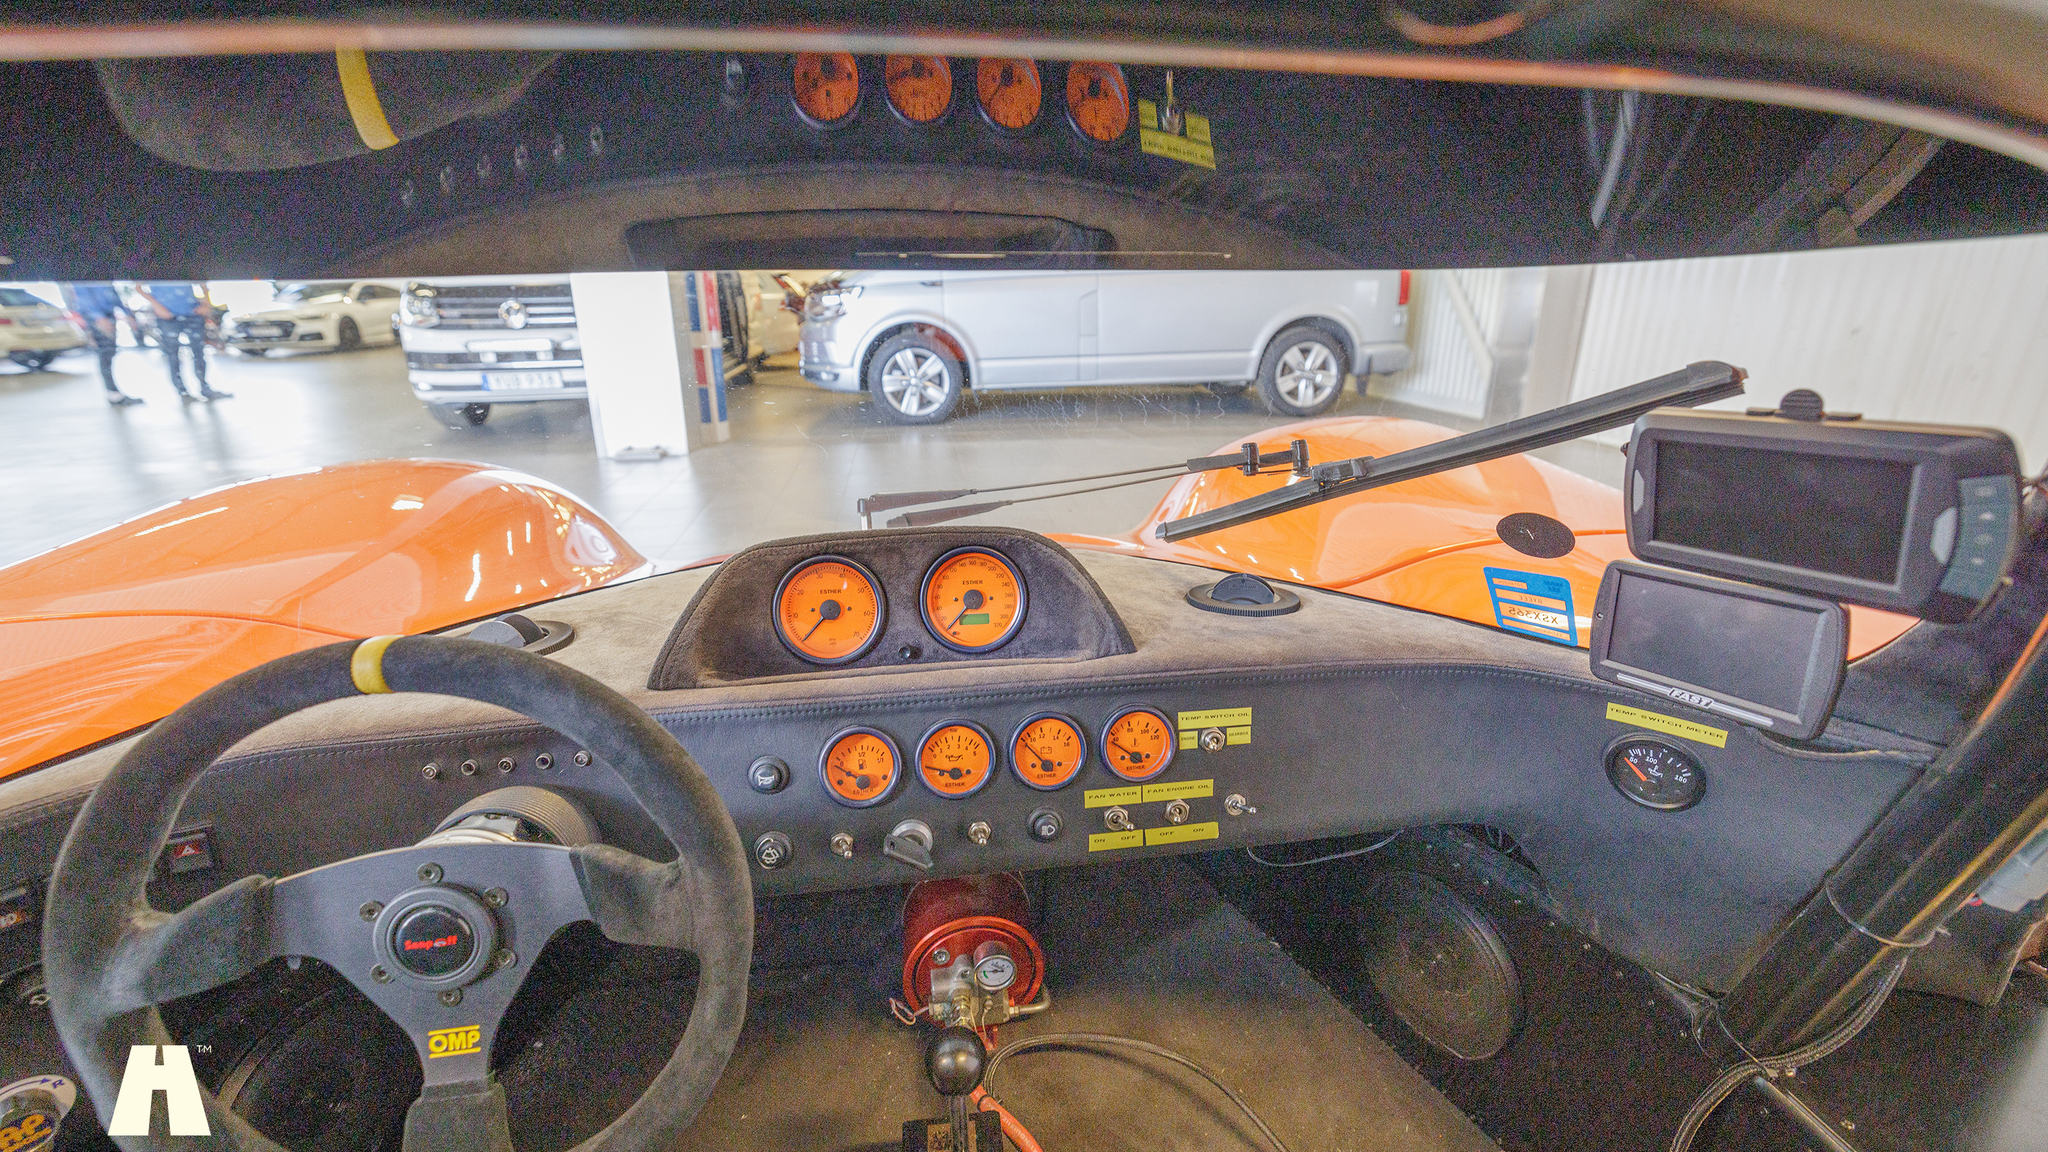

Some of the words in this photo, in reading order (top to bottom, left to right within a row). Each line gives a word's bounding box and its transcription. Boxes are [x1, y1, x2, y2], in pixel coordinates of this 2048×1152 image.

[1672, 688, 1712, 706] FAST
[1609, 707, 1637, 716] TEMP
[1641, 715, 1682, 728] SWITCH
[1686, 726, 1723, 739] METER
[1645, 756, 1658, 765] 100
[428, 1029, 481, 1053] OMP
[52, 1078, 66, 1090] R
